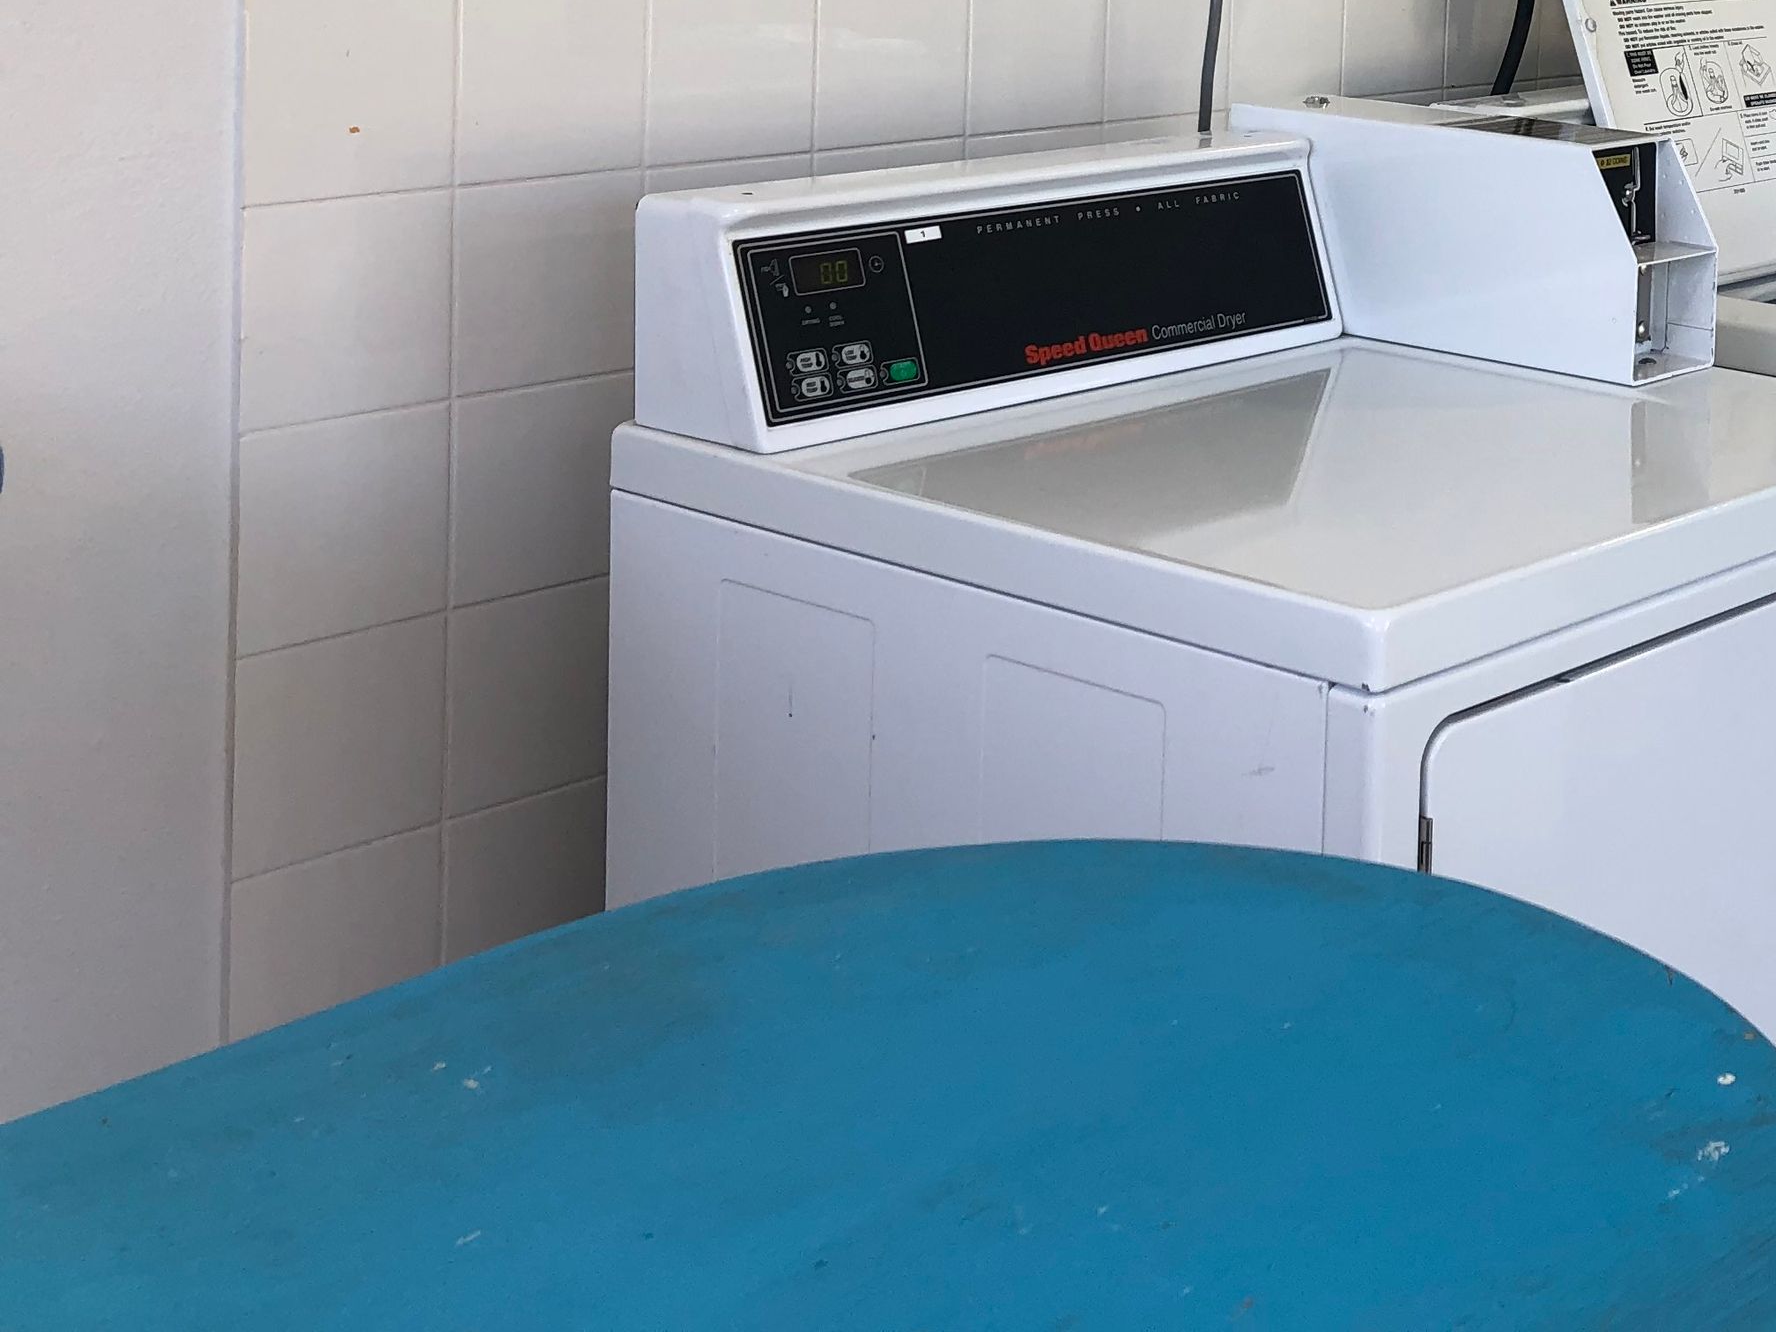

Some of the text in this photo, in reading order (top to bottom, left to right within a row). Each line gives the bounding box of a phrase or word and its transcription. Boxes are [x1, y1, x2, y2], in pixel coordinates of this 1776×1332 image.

[920, 230, 926, 238] 1
[976, 191, 1241, 235] PERMANENT PRESS ALL FABRIC
[1024, 310, 1248, 365] Speed Queen Commercial Dryer
